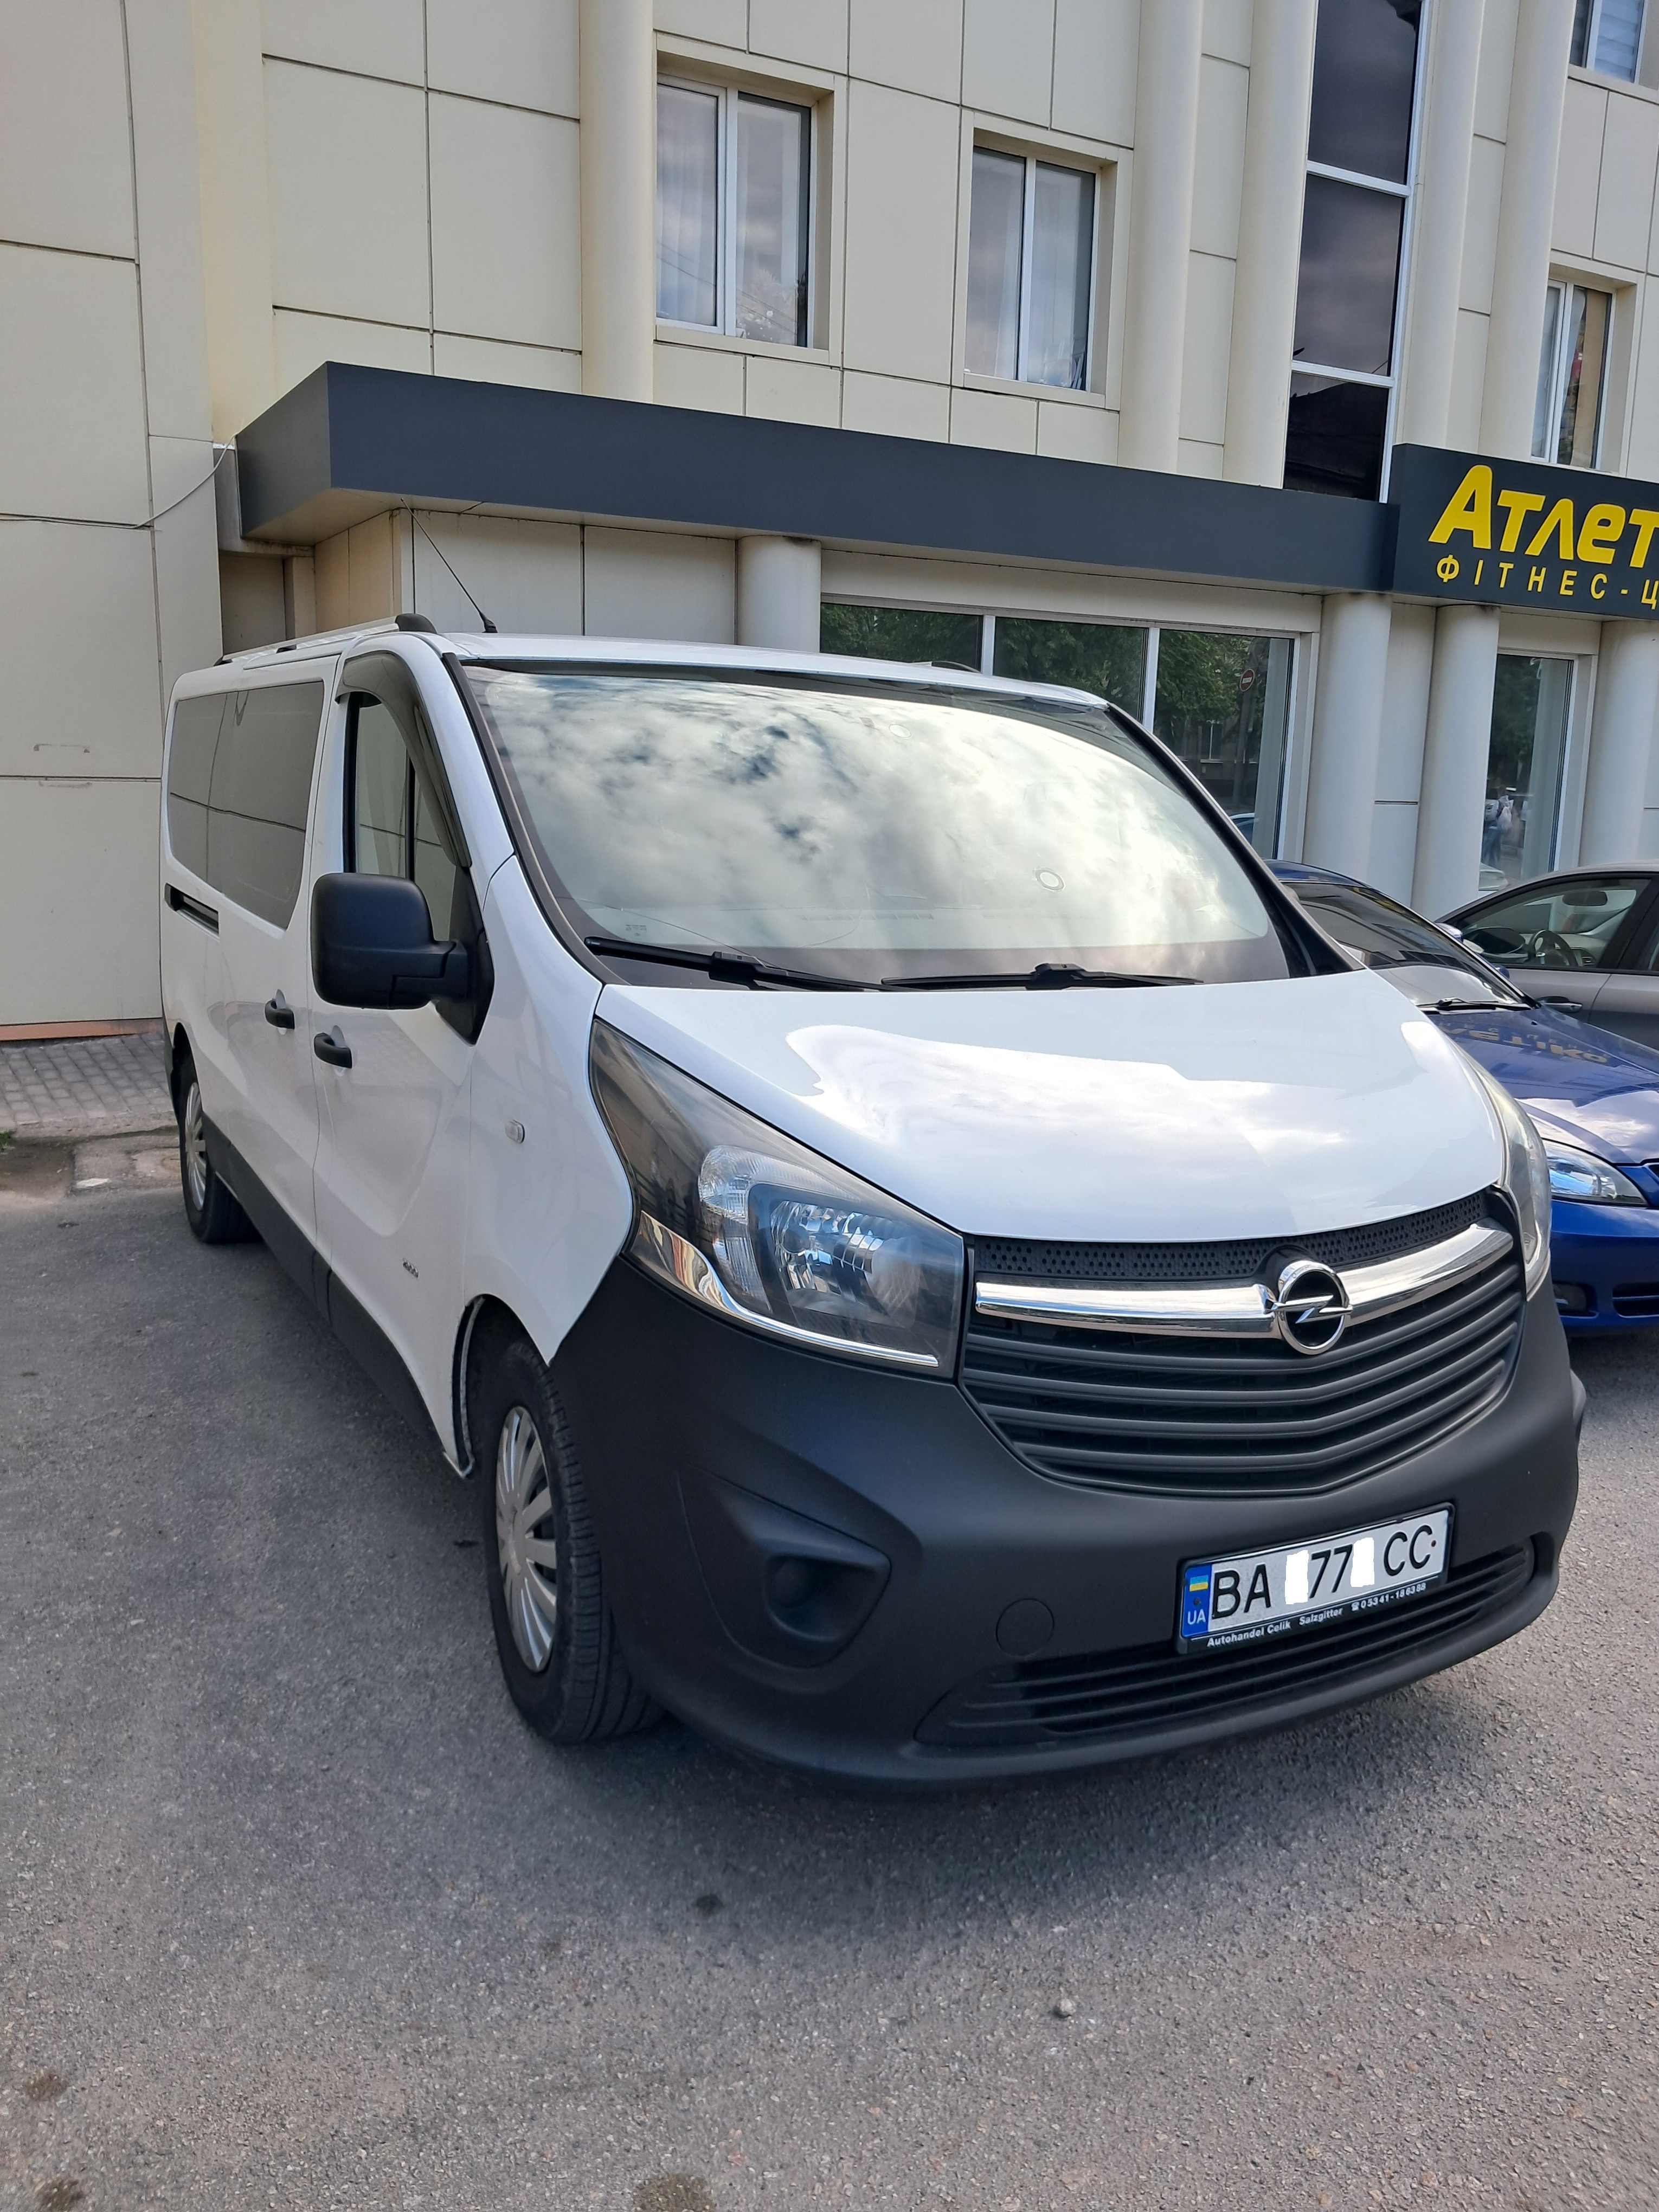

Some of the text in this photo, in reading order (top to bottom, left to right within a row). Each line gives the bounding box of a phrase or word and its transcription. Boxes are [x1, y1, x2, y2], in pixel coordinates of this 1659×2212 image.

[1211, 1564, 1271, 1619] BA
[1384, 1525, 1433, 1577] CC
[1187, 1607, 1206, 1625] UA
[1207, 1628, 1265, 1648] Autohandel
[1266, 1620, 1292, 1634] Celik
[1298, 1607, 1343, 1626] Salzgitter
